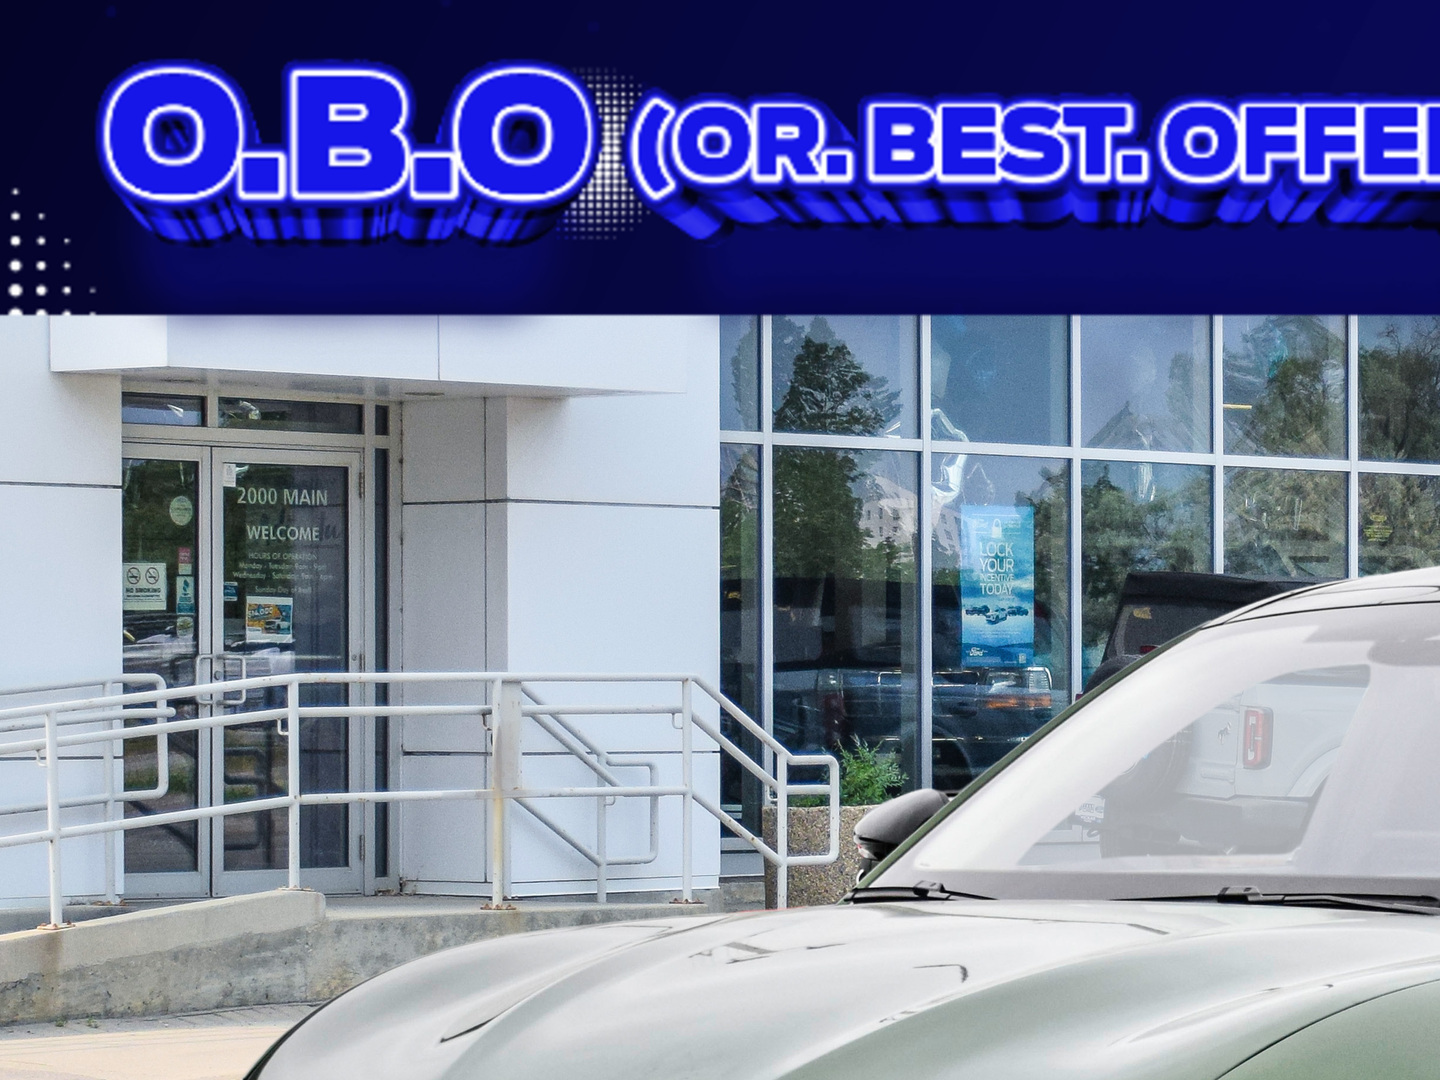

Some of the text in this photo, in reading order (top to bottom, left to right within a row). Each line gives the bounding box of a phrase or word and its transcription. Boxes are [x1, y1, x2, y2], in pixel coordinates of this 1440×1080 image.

[237, 487, 329, 506] 2000 MAIN
[246, 525, 320, 541] WELCOME
[979, 541, 1014, 557] LOCK
[979, 557, 1015, 573] YOUR
[979, 573, 1015, 582] INCENTIVE
[979, 583, 1014, 596] TODAY
[969, 646, 984, 657] Ford
